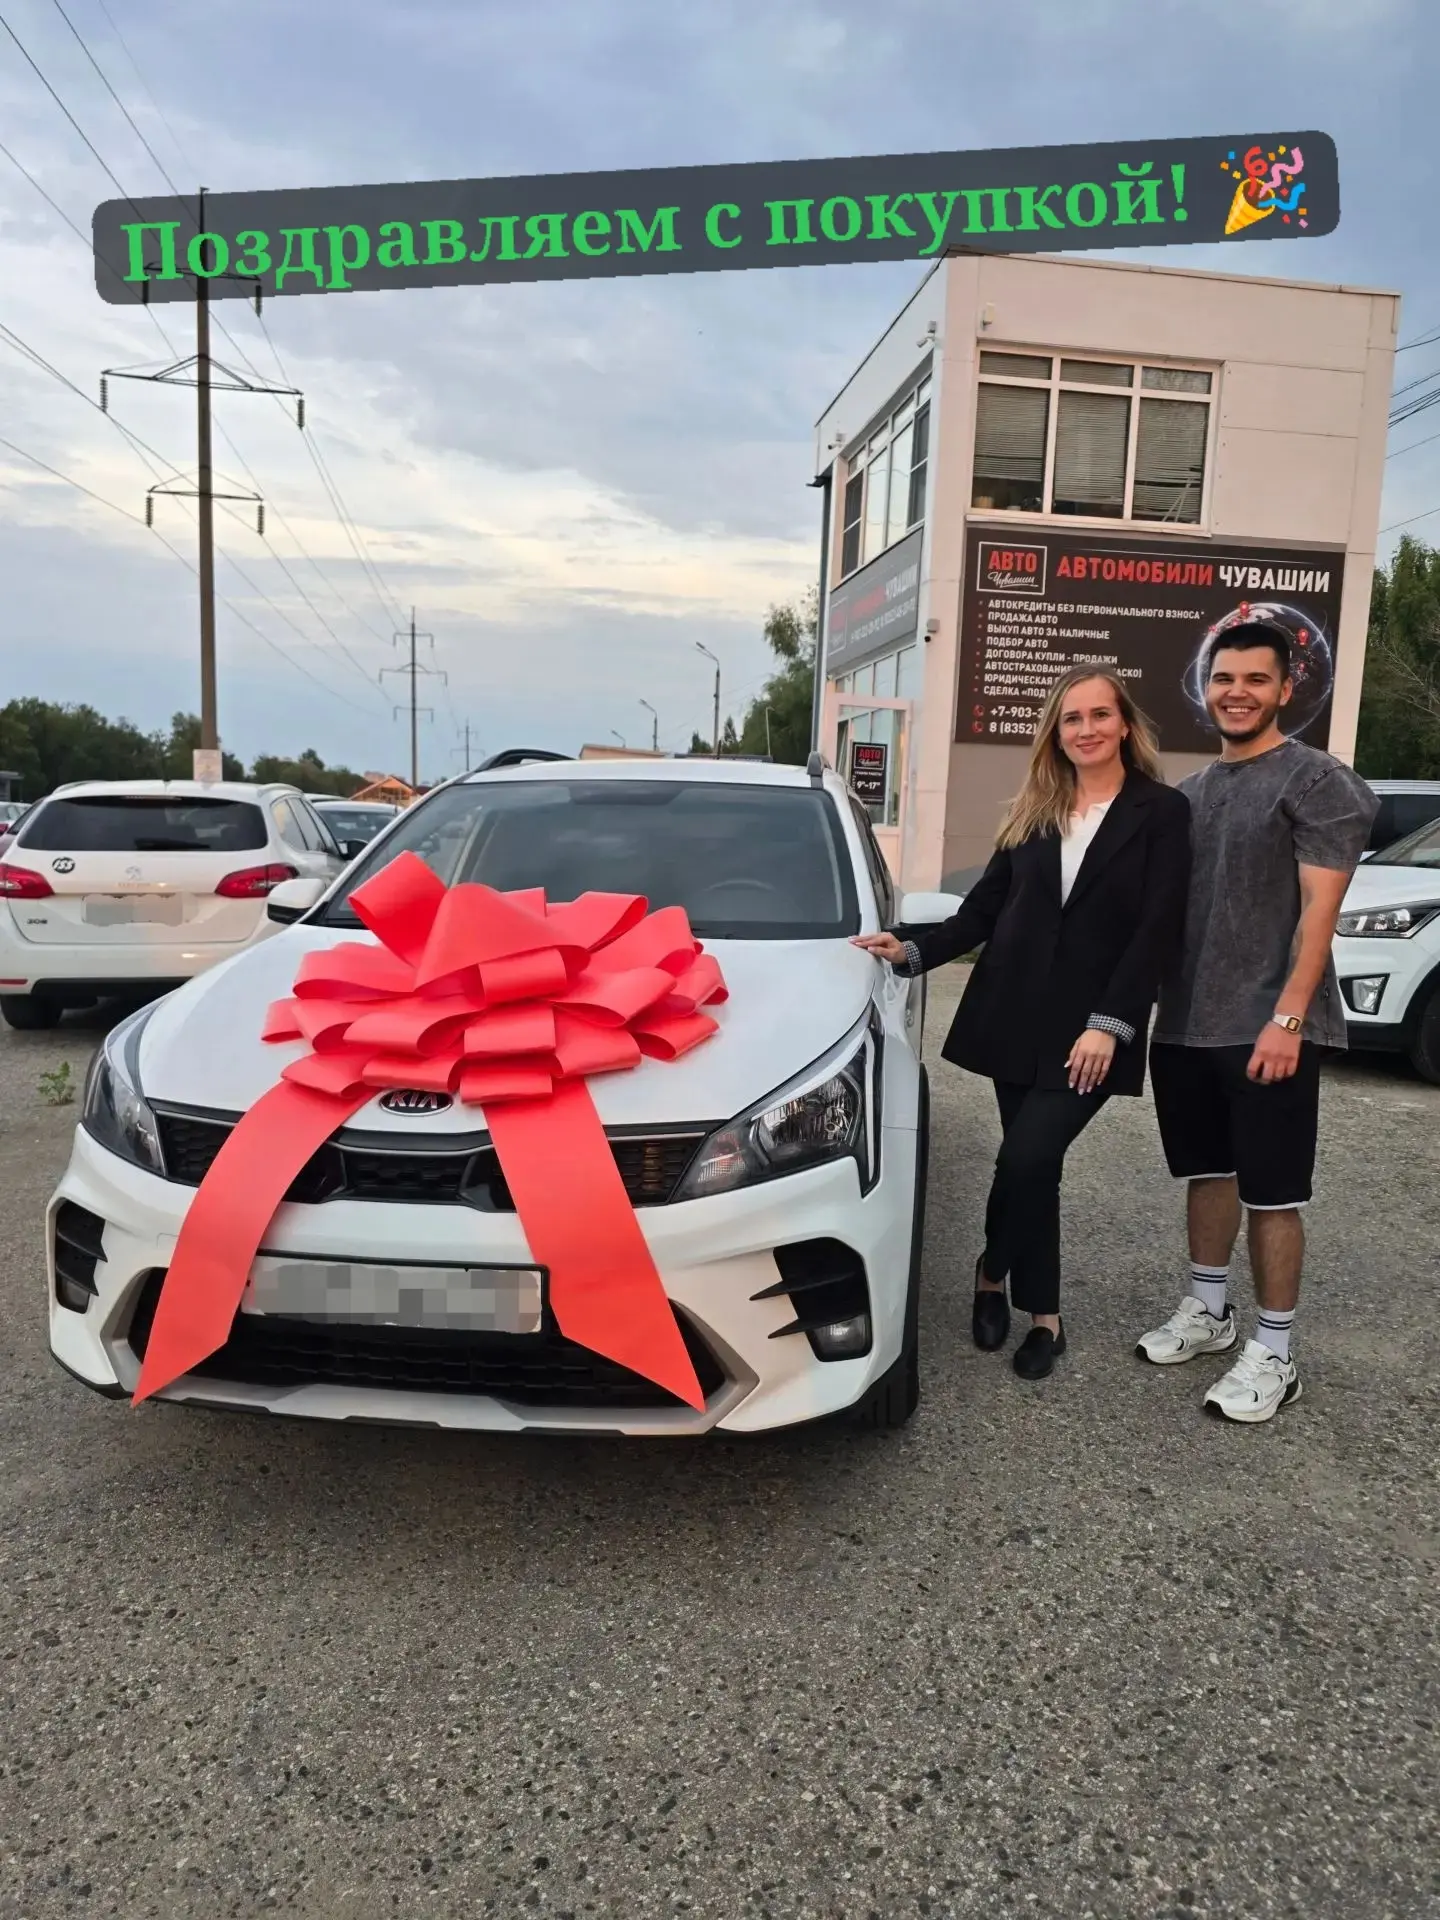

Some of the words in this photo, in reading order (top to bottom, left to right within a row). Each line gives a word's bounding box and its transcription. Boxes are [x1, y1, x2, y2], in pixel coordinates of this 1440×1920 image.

[988, 551, 1037, 572] АВТО
[1056, 556, 1213, 586] АВТОМОБИЛИ
[1219, 565, 1330, 592] ЧУВАШИИ
[988, 600, 1056, 612] АВТОКРЕДИТЫ
[1057, 603, 1074, 613] БЕЗ
[1076, 605, 1164, 618] ПЕРВОНАЧАЛЬНОГО
[988, 612, 1033, 623] ПРОДАЖА
[1034, 614, 1058, 624] АВТО
[987, 624, 1019, 635] ВЫКУП
[1020, 626, 1044, 635] АВТО
[1046, 628, 1058, 636] ЗА
[1059, 629, 1110, 640] НАЛИЧНЫЕ
[986, 636, 1023, 648] ПОДБОР
[1025, 638, 1048, 648] АВТО
[985, 649, 1033, 660] ДОГОВОРА
[1035, 651, 1065, 661] КУПЛИ
[1073, 653, 1118, 665] ПРОДАЖИ
[984, 673, 1053, 685] ЮРИДИЧЕСКАЯ
[983, 685, 1019, 696] СДЕЛКА
[990, 706, 1044, 718] +7-903-3
[989, 721, 997, 733] 8
[388, 1091, 438, 1109] KIA
